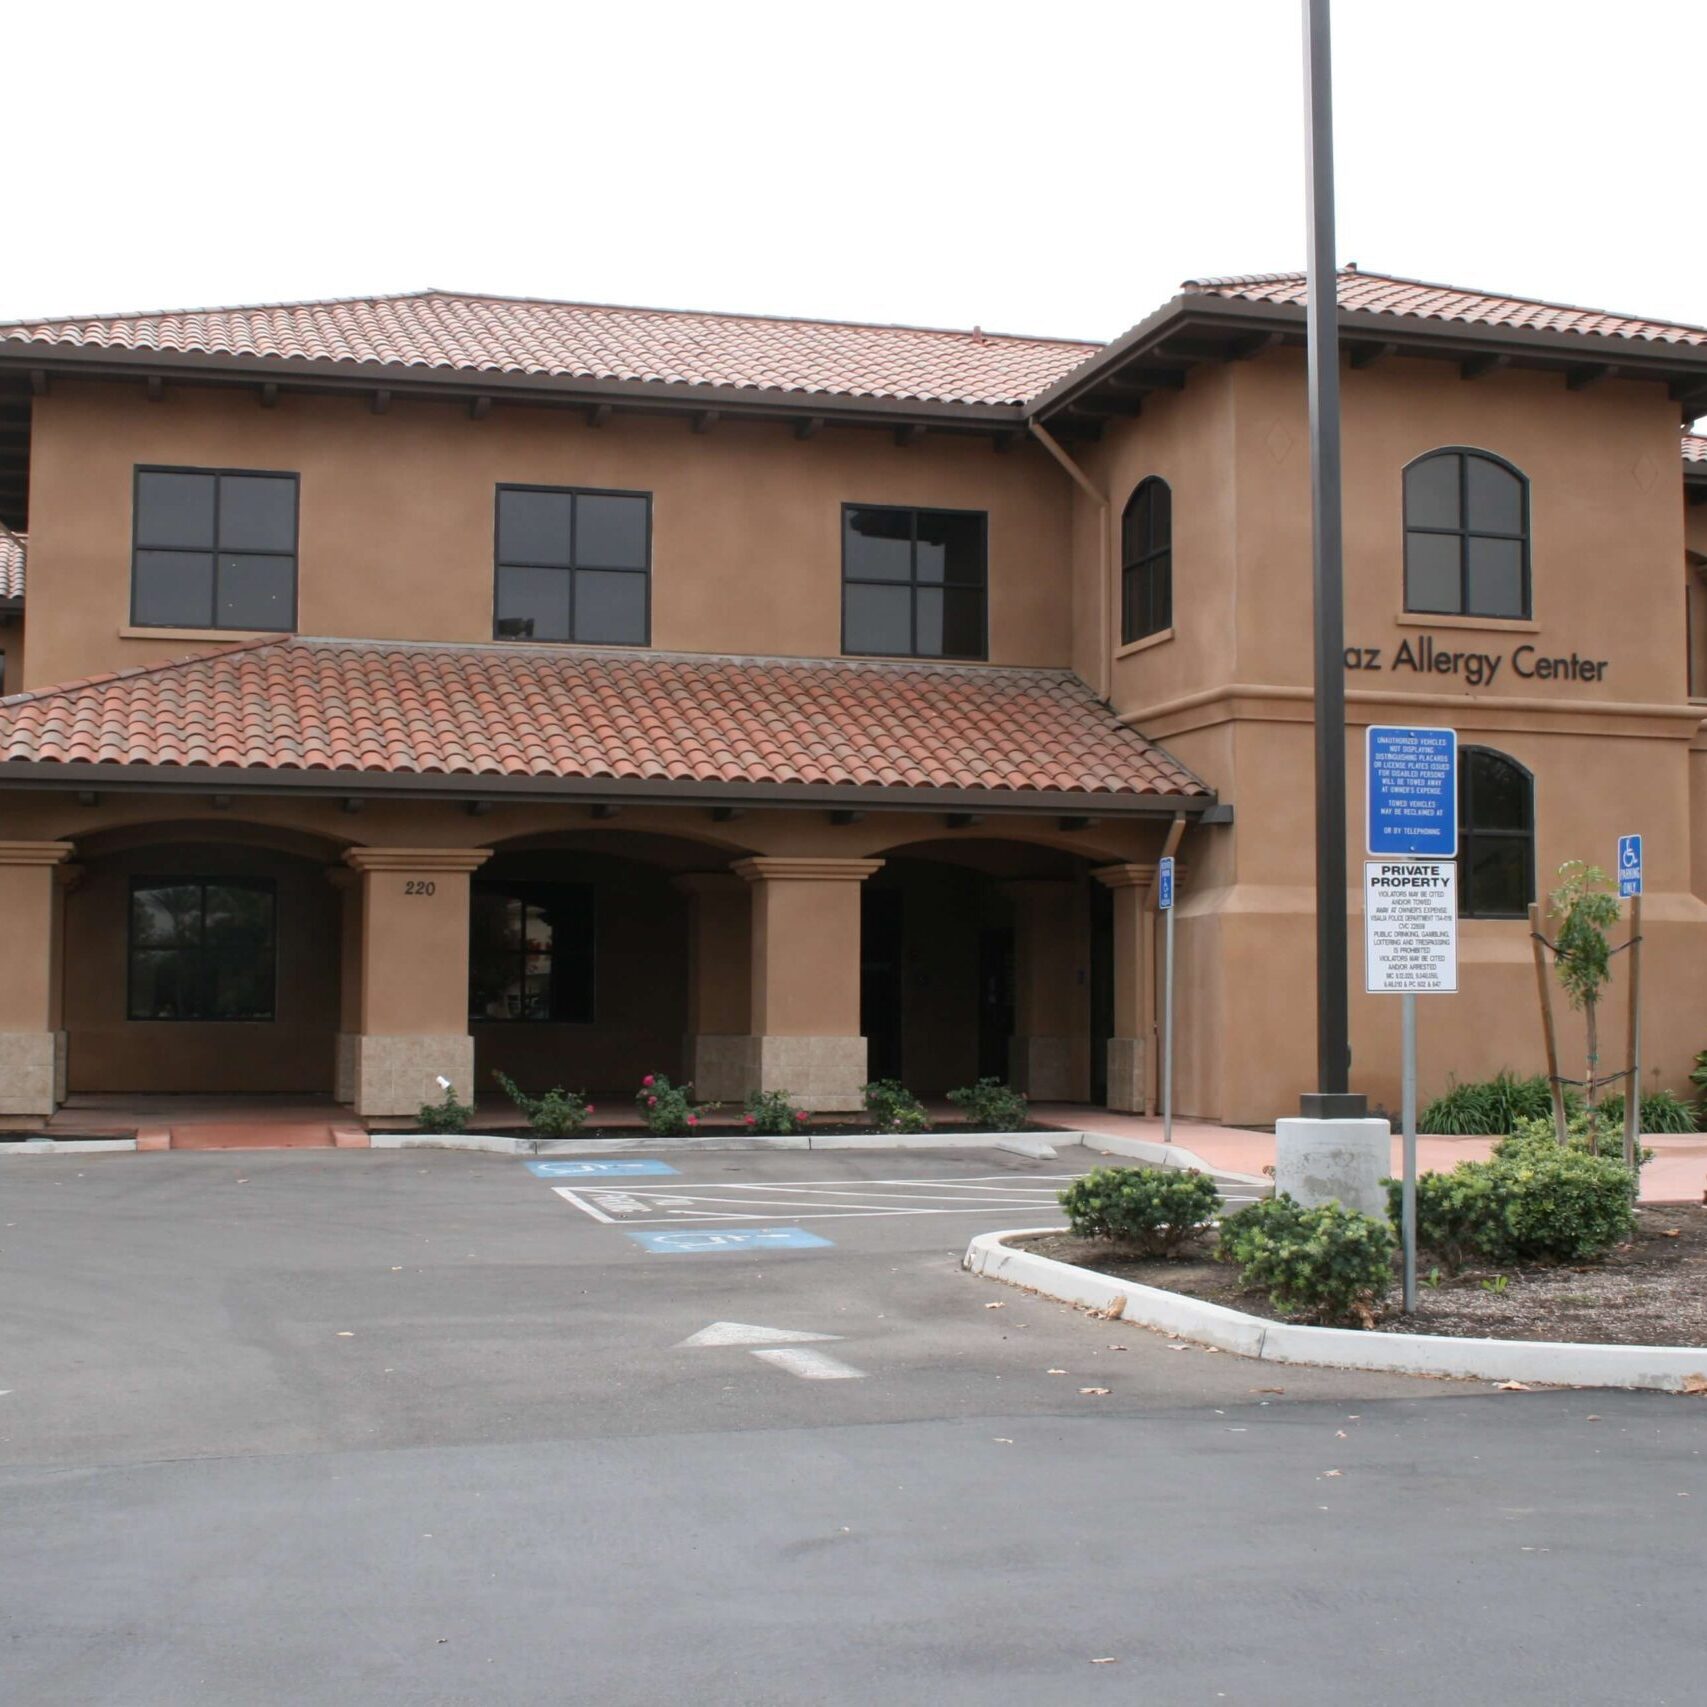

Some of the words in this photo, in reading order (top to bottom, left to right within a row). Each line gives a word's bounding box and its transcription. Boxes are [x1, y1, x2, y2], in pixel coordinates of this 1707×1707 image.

[1343, 647, 1381, 670] az
[1391, 635, 1502, 686] Allergy
[1511, 645, 1608, 682] Center
[1377, 737, 1418, 745] UNAUTHORIZED
[1420, 738, 1446, 746] VEHICLES
[1375, 753, 1417, 761] DISTINGUISHING
[1419, 754, 1448, 762] PLACARDS
[1409, 800, 1436, 808] VEHICLES
[1382, 866, 1440, 876] PRIVATE
[1371, 877, 1450, 887] PROPERTY
[404, 880, 436, 896] 220
